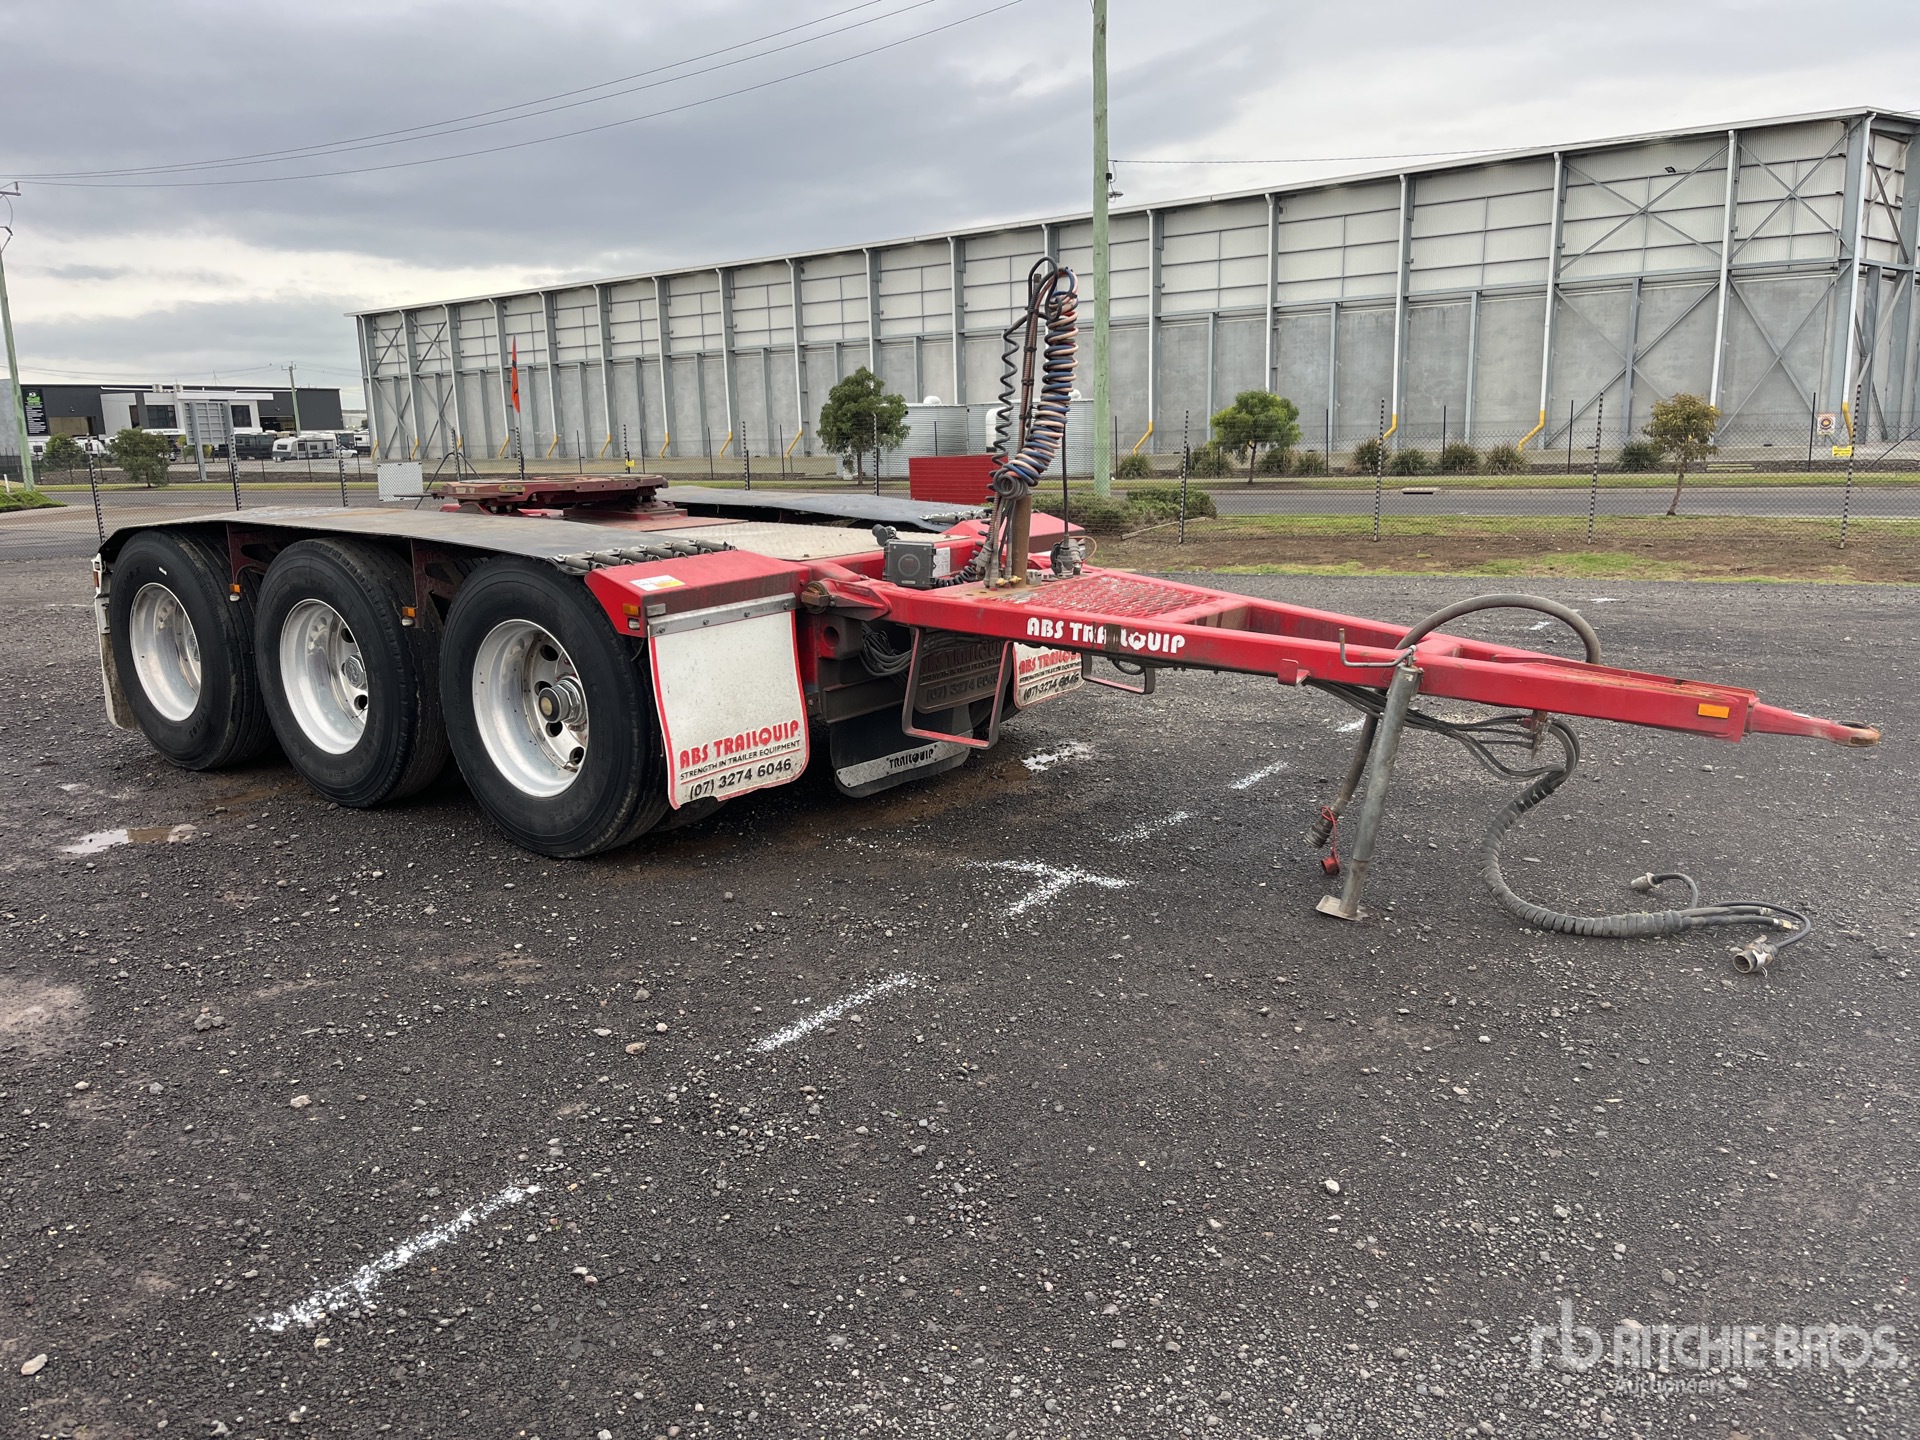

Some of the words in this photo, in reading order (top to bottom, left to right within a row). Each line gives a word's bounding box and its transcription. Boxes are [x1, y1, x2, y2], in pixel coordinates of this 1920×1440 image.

[1026, 617, 1064, 639] ABS
[1069, 621, 1186, 654] TRALQUIP
[679, 744, 709, 769] ABS
[713, 719, 799, 758] TRAILQUIP
[680, 762, 718, 780] STRENGTH
[718, 759, 727, 768] IN
[728, 751, 758, 766] TRAILER
[759, 740, 801, 757] EQUIPMENT
[889, 748, 934, 769] TRAILQUIP
[689, 779, 715, 800] (07)
[718, 768, 753, 789] 3274
[757, 758, 792, 778] 6046
